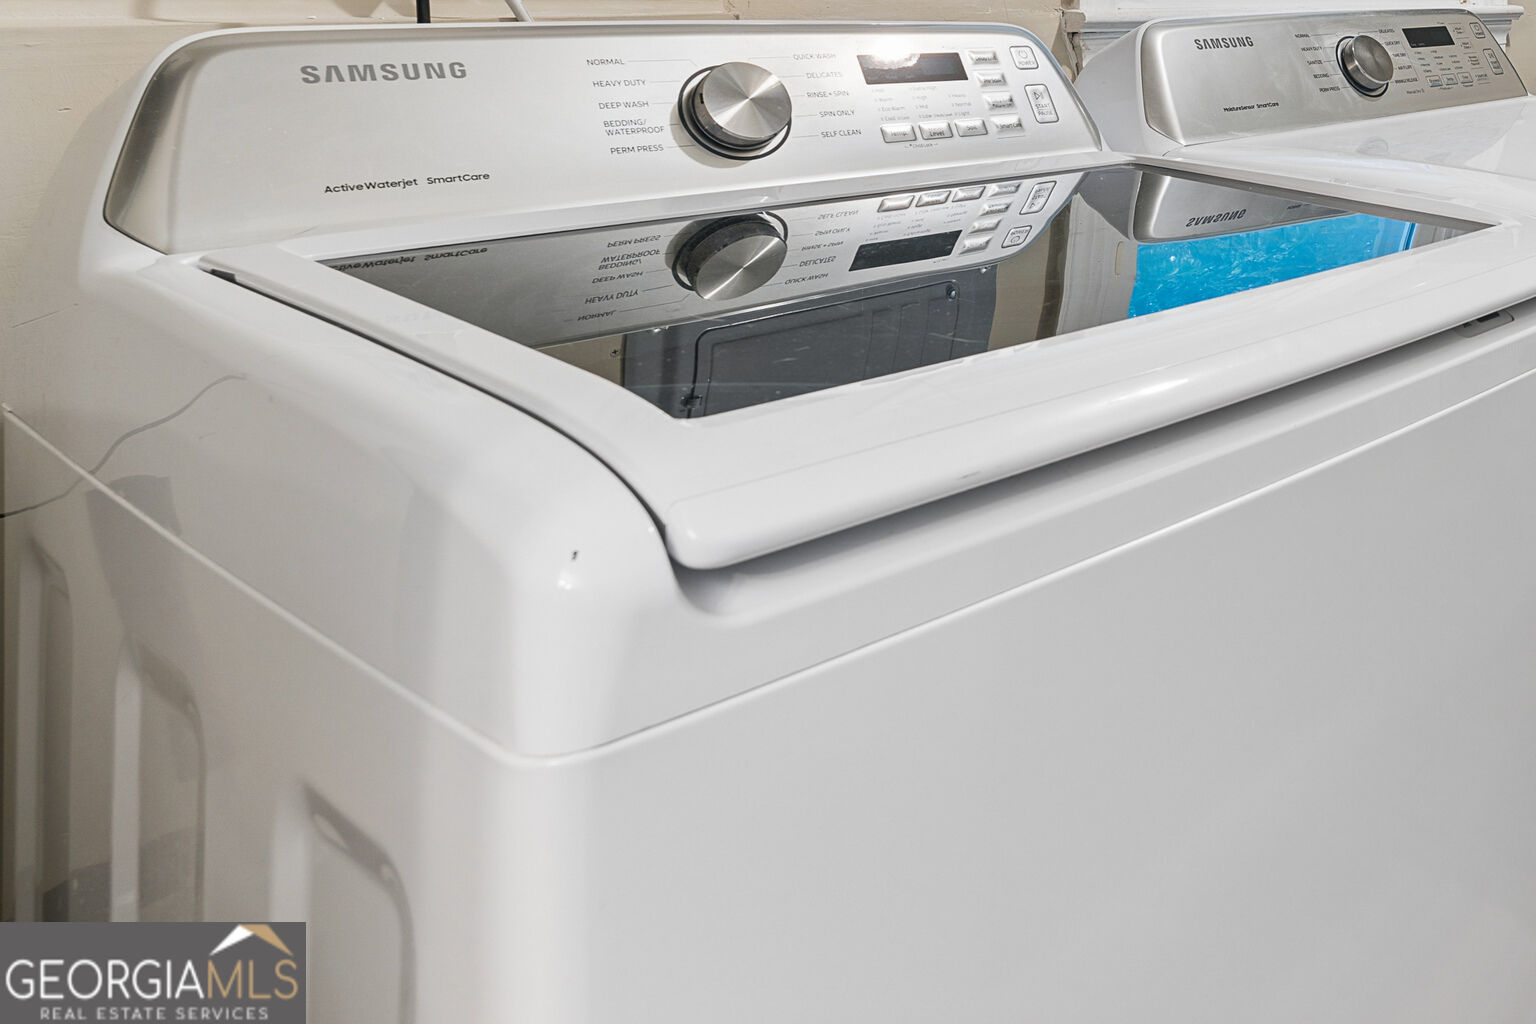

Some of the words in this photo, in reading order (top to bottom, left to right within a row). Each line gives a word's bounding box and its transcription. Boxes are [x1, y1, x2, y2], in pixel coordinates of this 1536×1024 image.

[1194, 36, 1254, 50] SAMSUNG
[586, 58, 626, 66] NORMAL
[793, 53, 815, 61] QUICK
[300, 61, 467, 84] SAMSUNG
[806, 71, 843, 79] DELICATES
[592, 80, 622, 88] HEAVY
[623, 79, 647, 87] DUTY
[598, 101, 622, 110] DEEP
[622, 100, 650, 109] WASH
[819, 110, 836, 118] SPIN
[836, 109, 856, 117] ONLY
[603, 119, 647, 128] BEDDING/
[605, 126, 665, 137] WATERPROOF
[821, 131, 838, 139] SELF
[838, 129, 862, 137] CLEAN
[610, 147, 636, 155] PERM
[637, 144, 664, 153] PRESS
[426, 172, 491, 185] SmartCare
